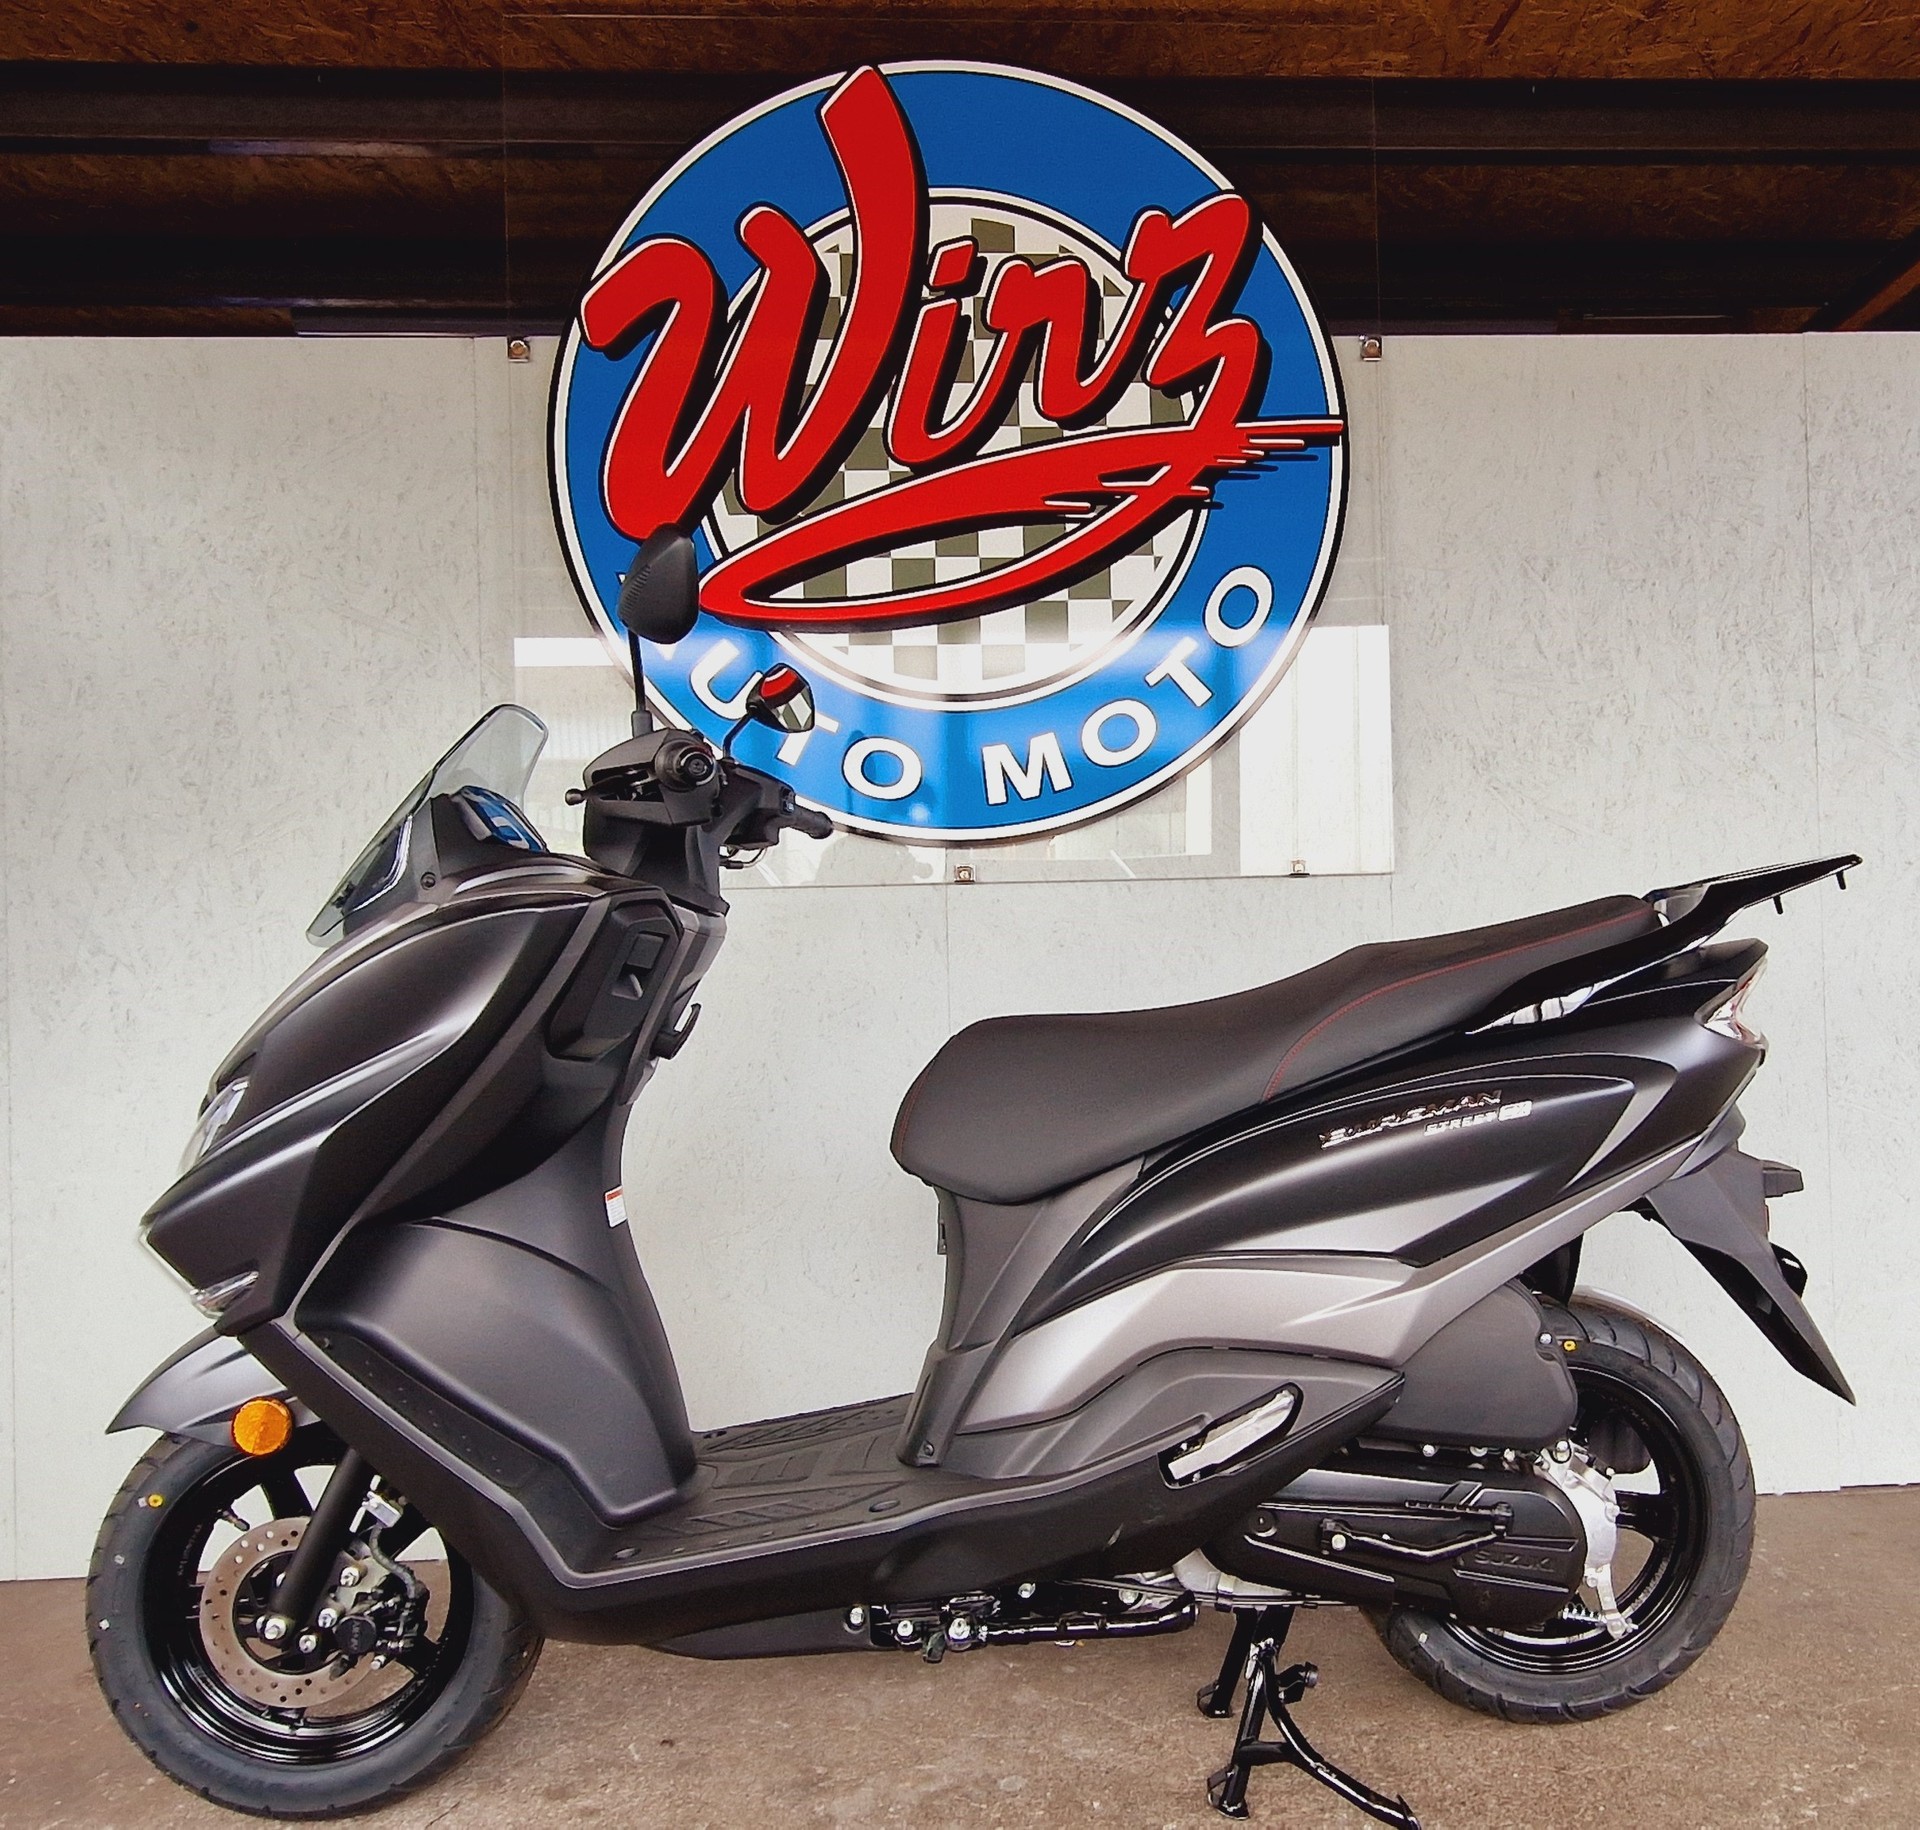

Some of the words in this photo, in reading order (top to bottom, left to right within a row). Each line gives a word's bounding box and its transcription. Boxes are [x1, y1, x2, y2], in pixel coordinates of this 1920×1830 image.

[618, 572, 922, 801] UTO
[981, 565, 1274, 805] MOTO
[1474, 1550, 1555, 1573] SUZUKI
